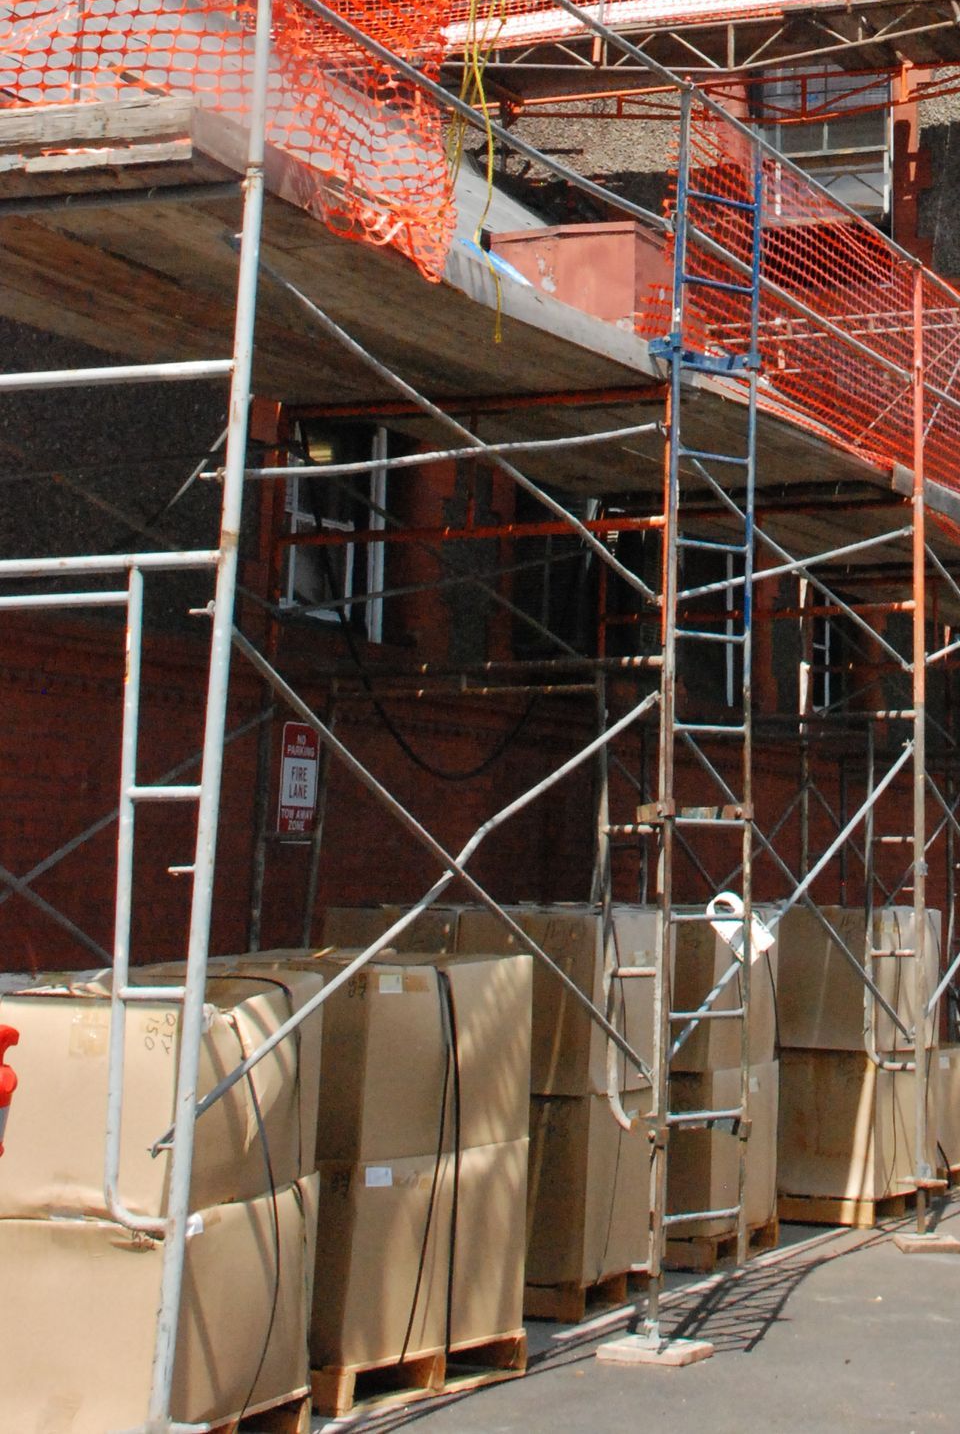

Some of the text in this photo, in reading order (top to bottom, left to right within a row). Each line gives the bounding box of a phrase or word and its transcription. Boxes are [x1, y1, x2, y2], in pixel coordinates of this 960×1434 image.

[297, 733, 307, 745] NO
[287, 744, 315, 757] PARKING
[291, 766, 308, 782] FIRE
[288, 783, 308, 799] LANE
[281, 808, 313, 820] TOW AWAY
[287, 820, 305, 831] ZONE
[143, 1017, 161, 1051] 150
[160, 1012, 177, 1055] QTY
